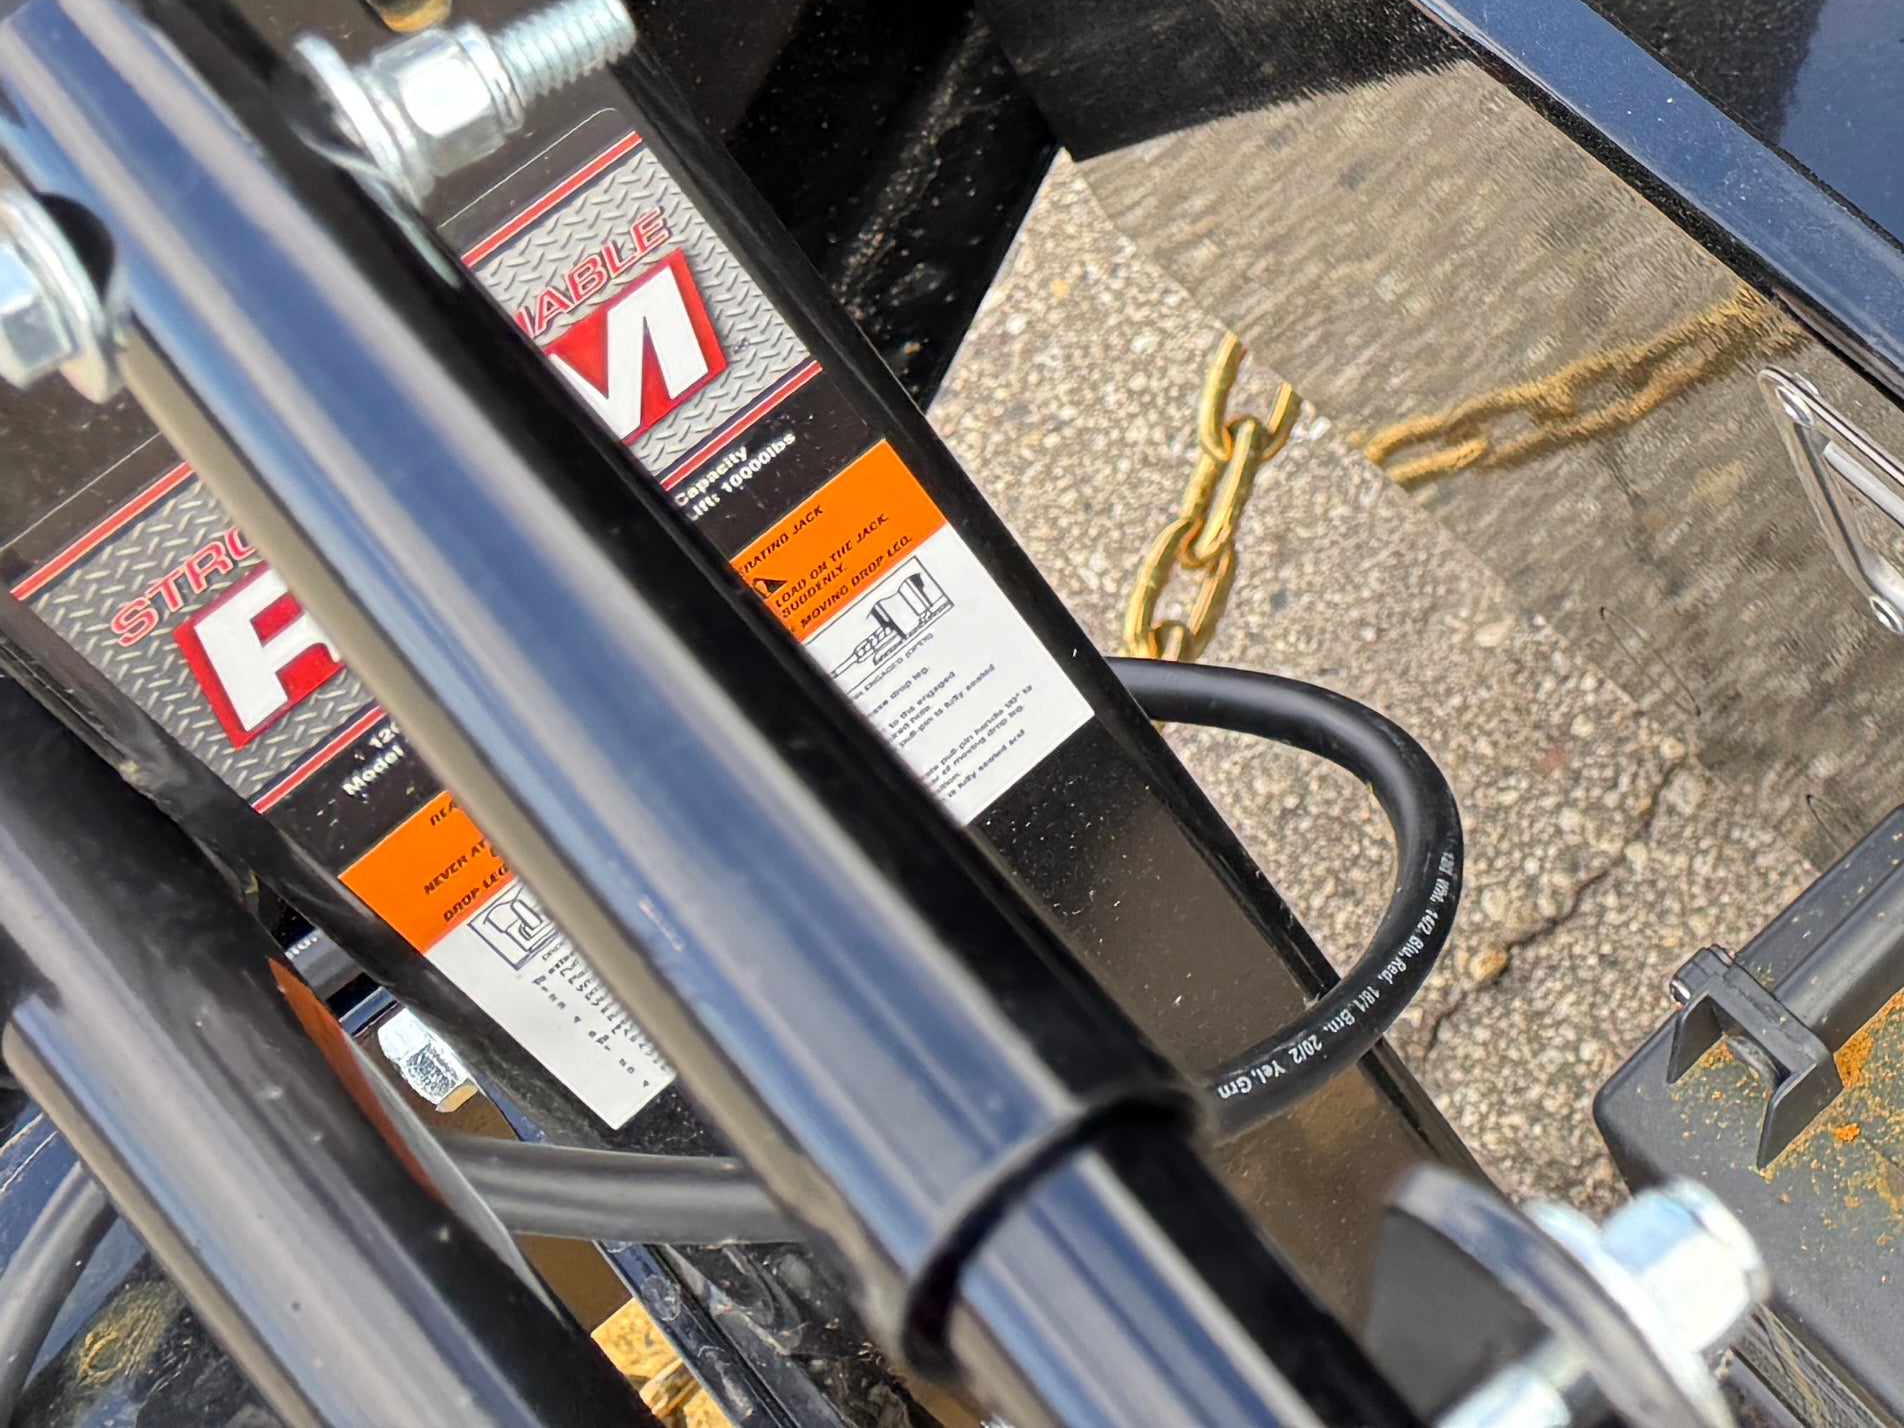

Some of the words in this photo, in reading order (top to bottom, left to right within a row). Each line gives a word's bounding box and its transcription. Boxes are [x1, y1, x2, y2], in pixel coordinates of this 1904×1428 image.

[672, 444, 751, 509] Capacity
[789, 504, 824, 535] JACK
[342, 744, 406, 796] Model
[720, 430, 798, 494] 10000lbs
[915, 670, 957, 707] engaged
[420, 854, 470, 895] NEVER
[773, 577, 808, 608] LOAD
[807, 561, 829, 580] ON
[828, 539, 855, 563] THE
[440, 885, 484, 922] DROP
[798, 584, 849, 627] MOVING
[849, 554, 886, 586] DROP
[1287, 1032, 1324, 1065] 20/2
[1216, 1073, 1255, 1103] Grn
